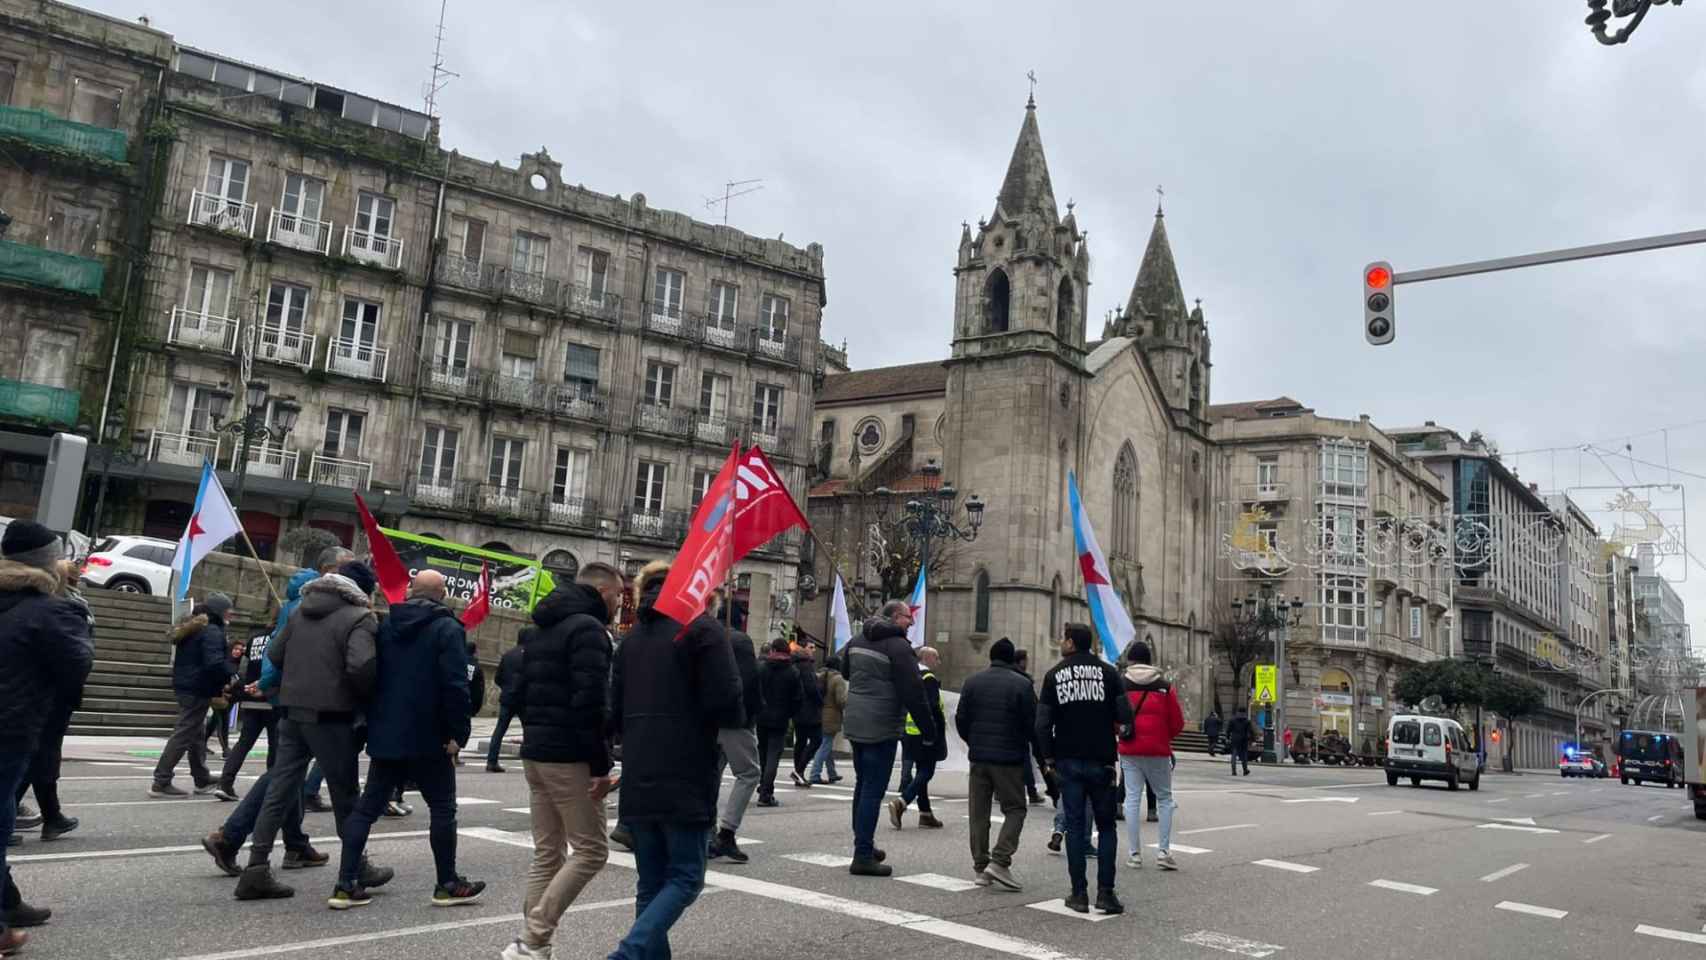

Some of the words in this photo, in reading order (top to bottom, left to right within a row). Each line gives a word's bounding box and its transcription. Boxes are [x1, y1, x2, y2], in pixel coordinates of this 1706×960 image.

[1055, 666, 1073, 683] NON
[1073, 665, 1104, 680] SOMOS
[1055, 680, 1105, 704] ESCRAVOS
